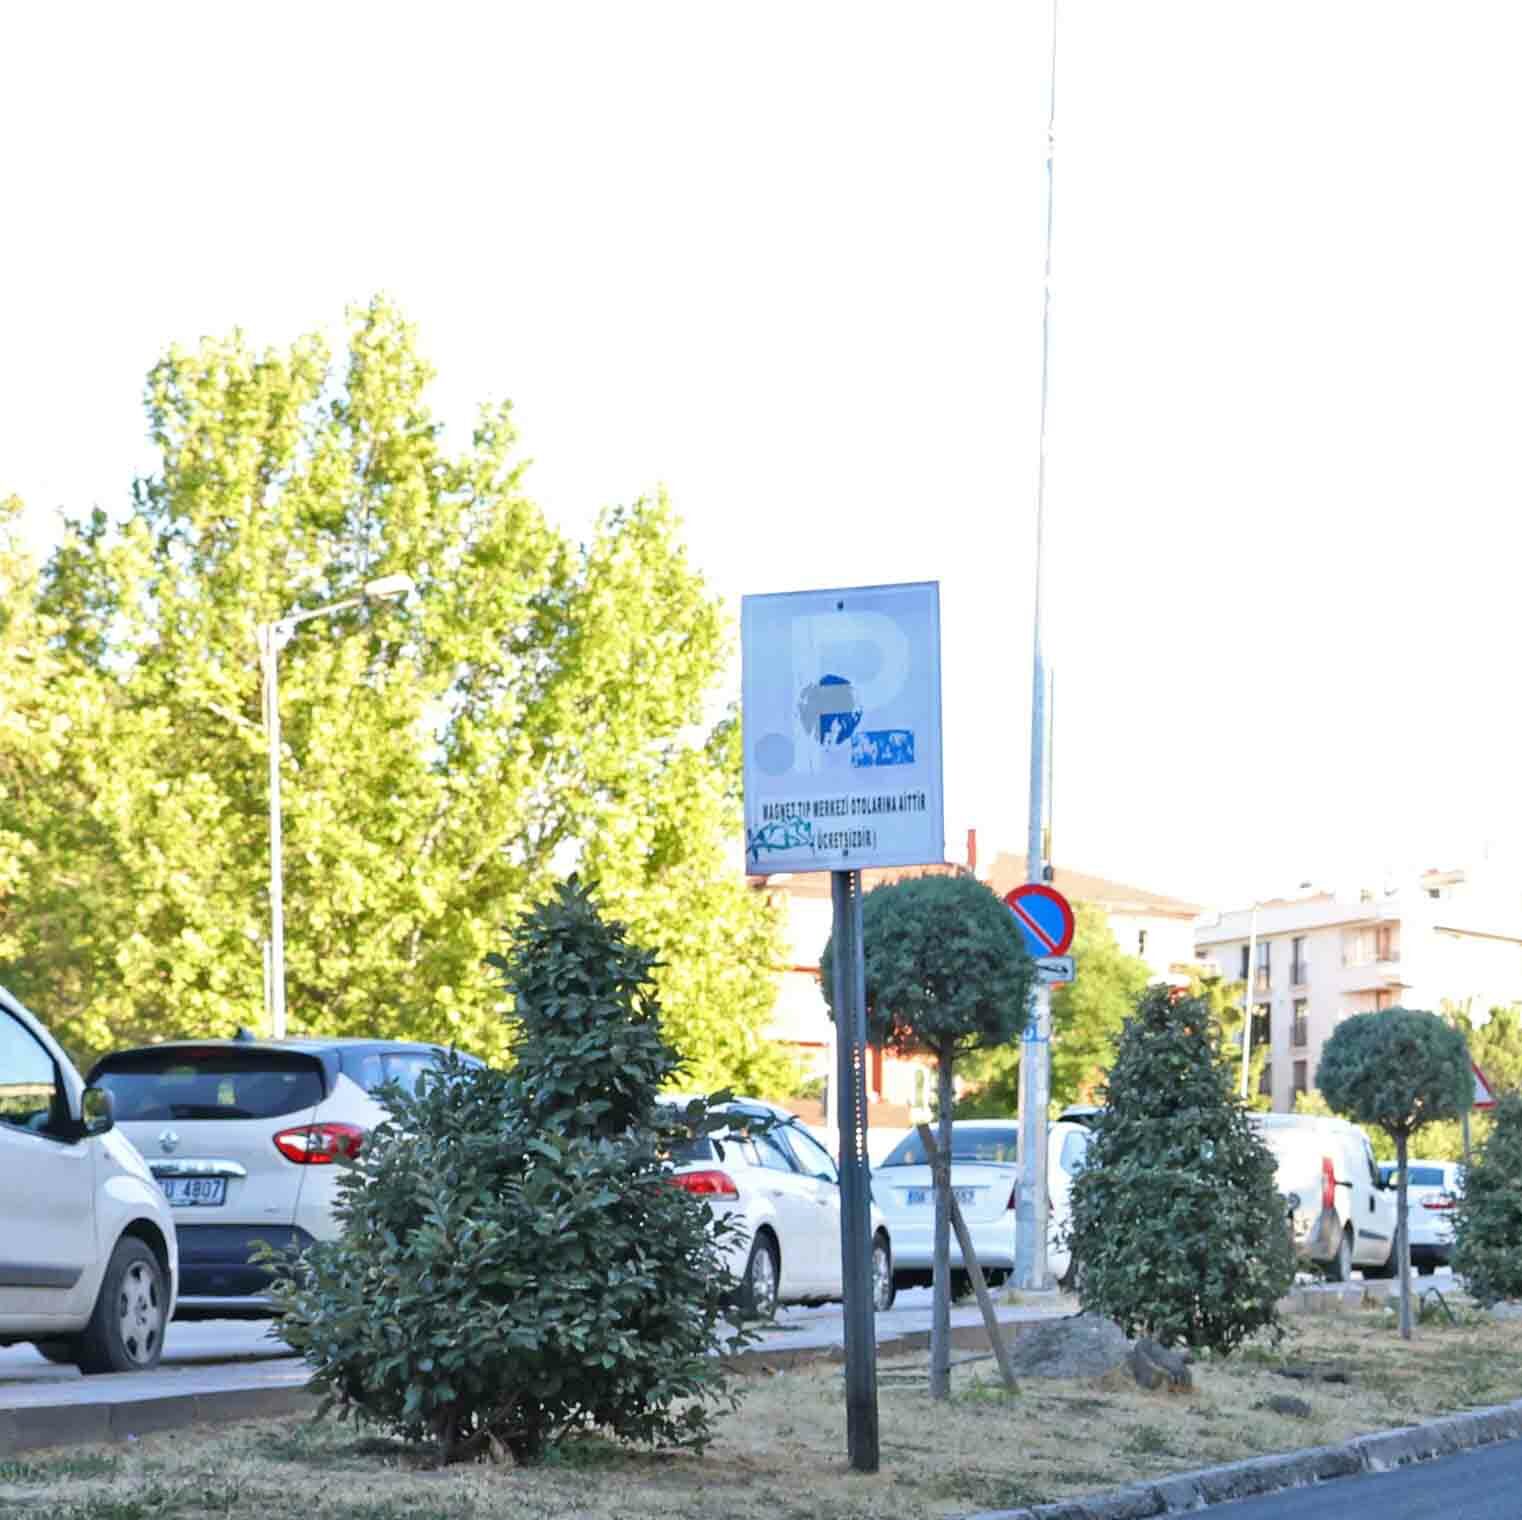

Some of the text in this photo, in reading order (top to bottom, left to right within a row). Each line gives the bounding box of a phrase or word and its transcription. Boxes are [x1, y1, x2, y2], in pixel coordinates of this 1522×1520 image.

[813, 794, 849, 816] MERKEZİ
[899, 790, 926, 812] AİTTİR
[183, 1180, 221, 1199] 4807
